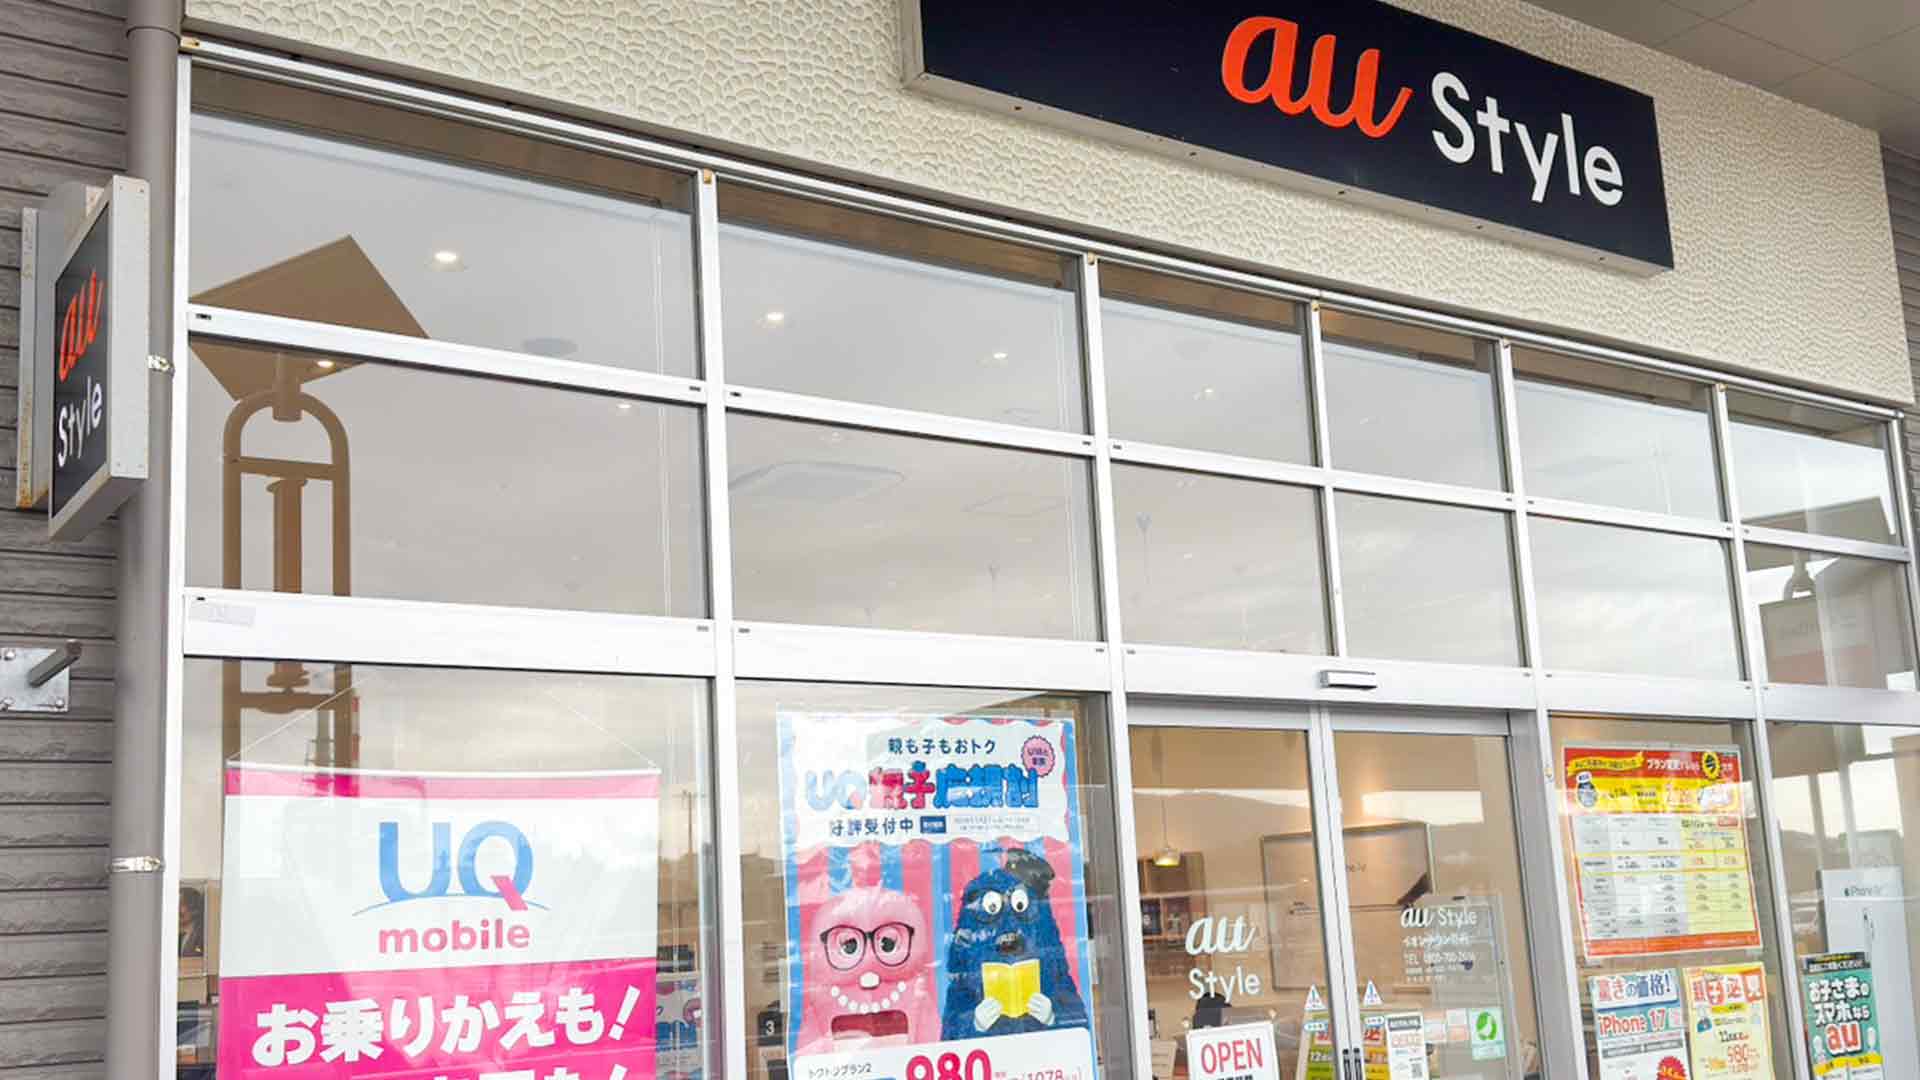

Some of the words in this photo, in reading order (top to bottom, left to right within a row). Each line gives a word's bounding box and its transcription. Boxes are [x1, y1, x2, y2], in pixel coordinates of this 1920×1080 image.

[1221, 16, 1413, 138] au
[1431, 72, 1624, 206] Style
[59, 272, 103, 381] au
[58, 381, 102, 467] Style
[888, 738, 996, 755] 親も子もおトク
[829, 816, 914, 837] 好評受付中
[379, 821, 534, 911] UQ
[1401, 908, 1434, 928] au
[1439, 907, 1477, 928] Style
[379, 919, 530, 953] mobile
[1185, 915, 1256, 956] au
[1188, 964, 1260, 1003] Style
[1809, 977, 1870, 1002] お子さまの
[251, 985, 641, 1067] お乗りかえも!
[1600, 1014, 1647, 1036] iPhone
[1814, 1001, 1871, 1026] スマホなら
[1825, 1021, 1862, 1053] au
[906, 1049, 992, 1080] 980
[1201, 1038, 1263, 1074] OPEN
